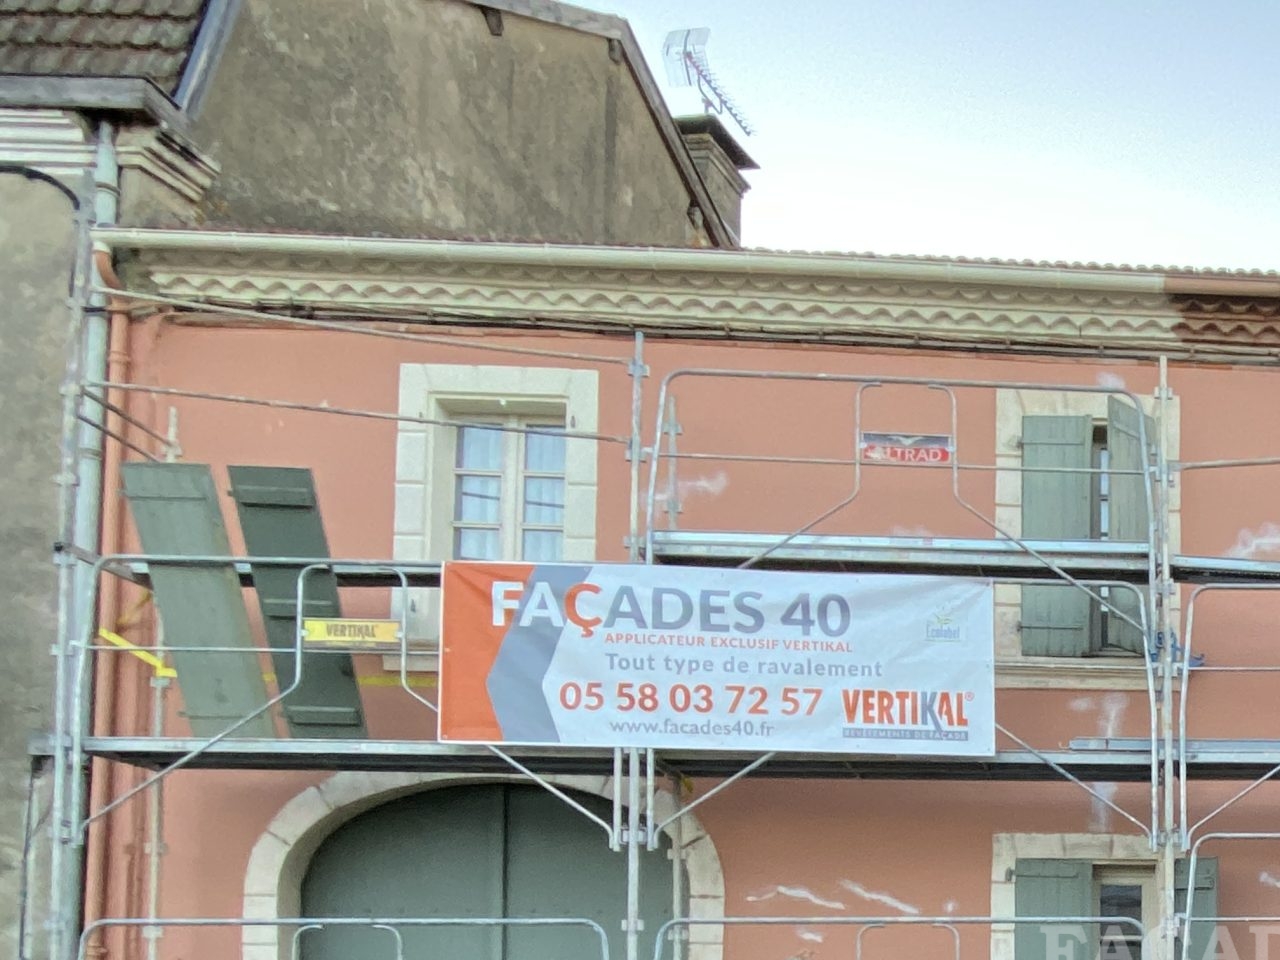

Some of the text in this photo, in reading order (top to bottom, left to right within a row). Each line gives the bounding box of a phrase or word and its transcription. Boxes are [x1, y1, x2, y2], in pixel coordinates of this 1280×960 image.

[872, 447, 942, 461] LTRAD
[492, 581, 851, 638] FAÇADES 40
[605, 633, 852, 652] APPLICATEUR EXCLUSIF VERTIKAL
[608, 654, 882, 677] Tout type de ravalement
[560, 682, 822, 716] 05 58 03 72 57
[610, 718, 774, 737] www.facades40.fr
